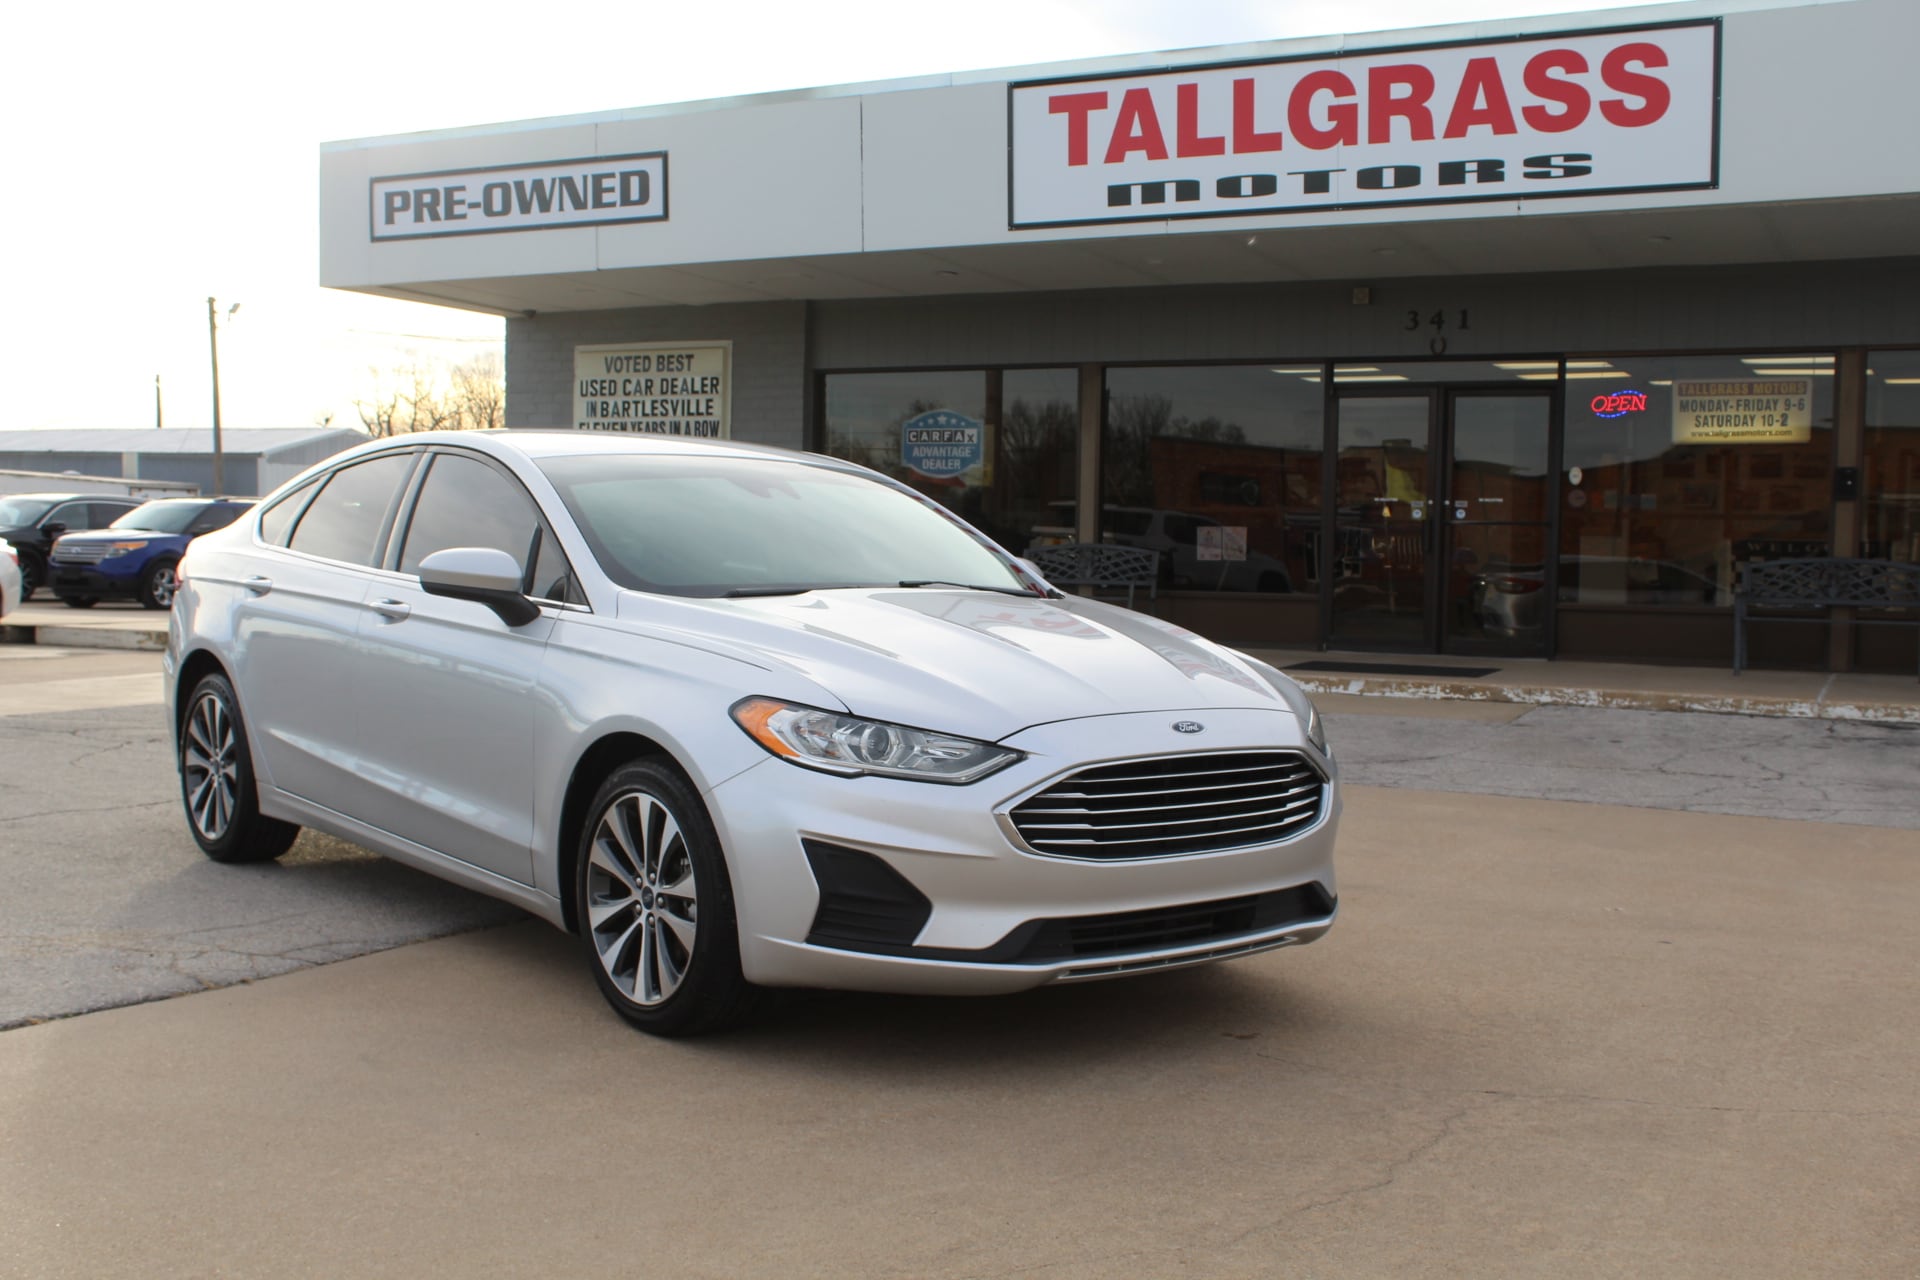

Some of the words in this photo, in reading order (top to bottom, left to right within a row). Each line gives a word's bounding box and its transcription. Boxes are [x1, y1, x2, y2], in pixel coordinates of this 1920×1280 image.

[1048, 42, 1671, 166] TALLGRASS
[1107, 153, 1592, 207] MOTORS
[383, 169, 650, 225] PRE-OWNED
[605, 356, 651, 373] VOTED
[656, 354, 694, 372] BEST
[580, 379, 617, 397] USED
[623, 378, 653, 396] CAR
[660, 377, 719, 395] DEALER
[1680, 382, 1749, 395] TALLGRASS
[1753, 381, 1806, 394] MOTORS
[586, 401, 597, 418] IN
[601, 399, 713, 417] BARTLESVILLE
[1590, 394, 1648, 413] OPEN
[631, 421, 666, 434] YEARS
[669, 420, 681, 435] IN
[684, 420, 692, 436] A
[694, 420, 720, 437] ROW
[1694, 414, 1756, 428] SATURDAY
[1761, 413, 1789, 427] 10-2
[908, 430, 977, 443] CARFAX
[912, 446, 972, 458] ADVANTAGE
[922, 459, 961, 470] DEALER
